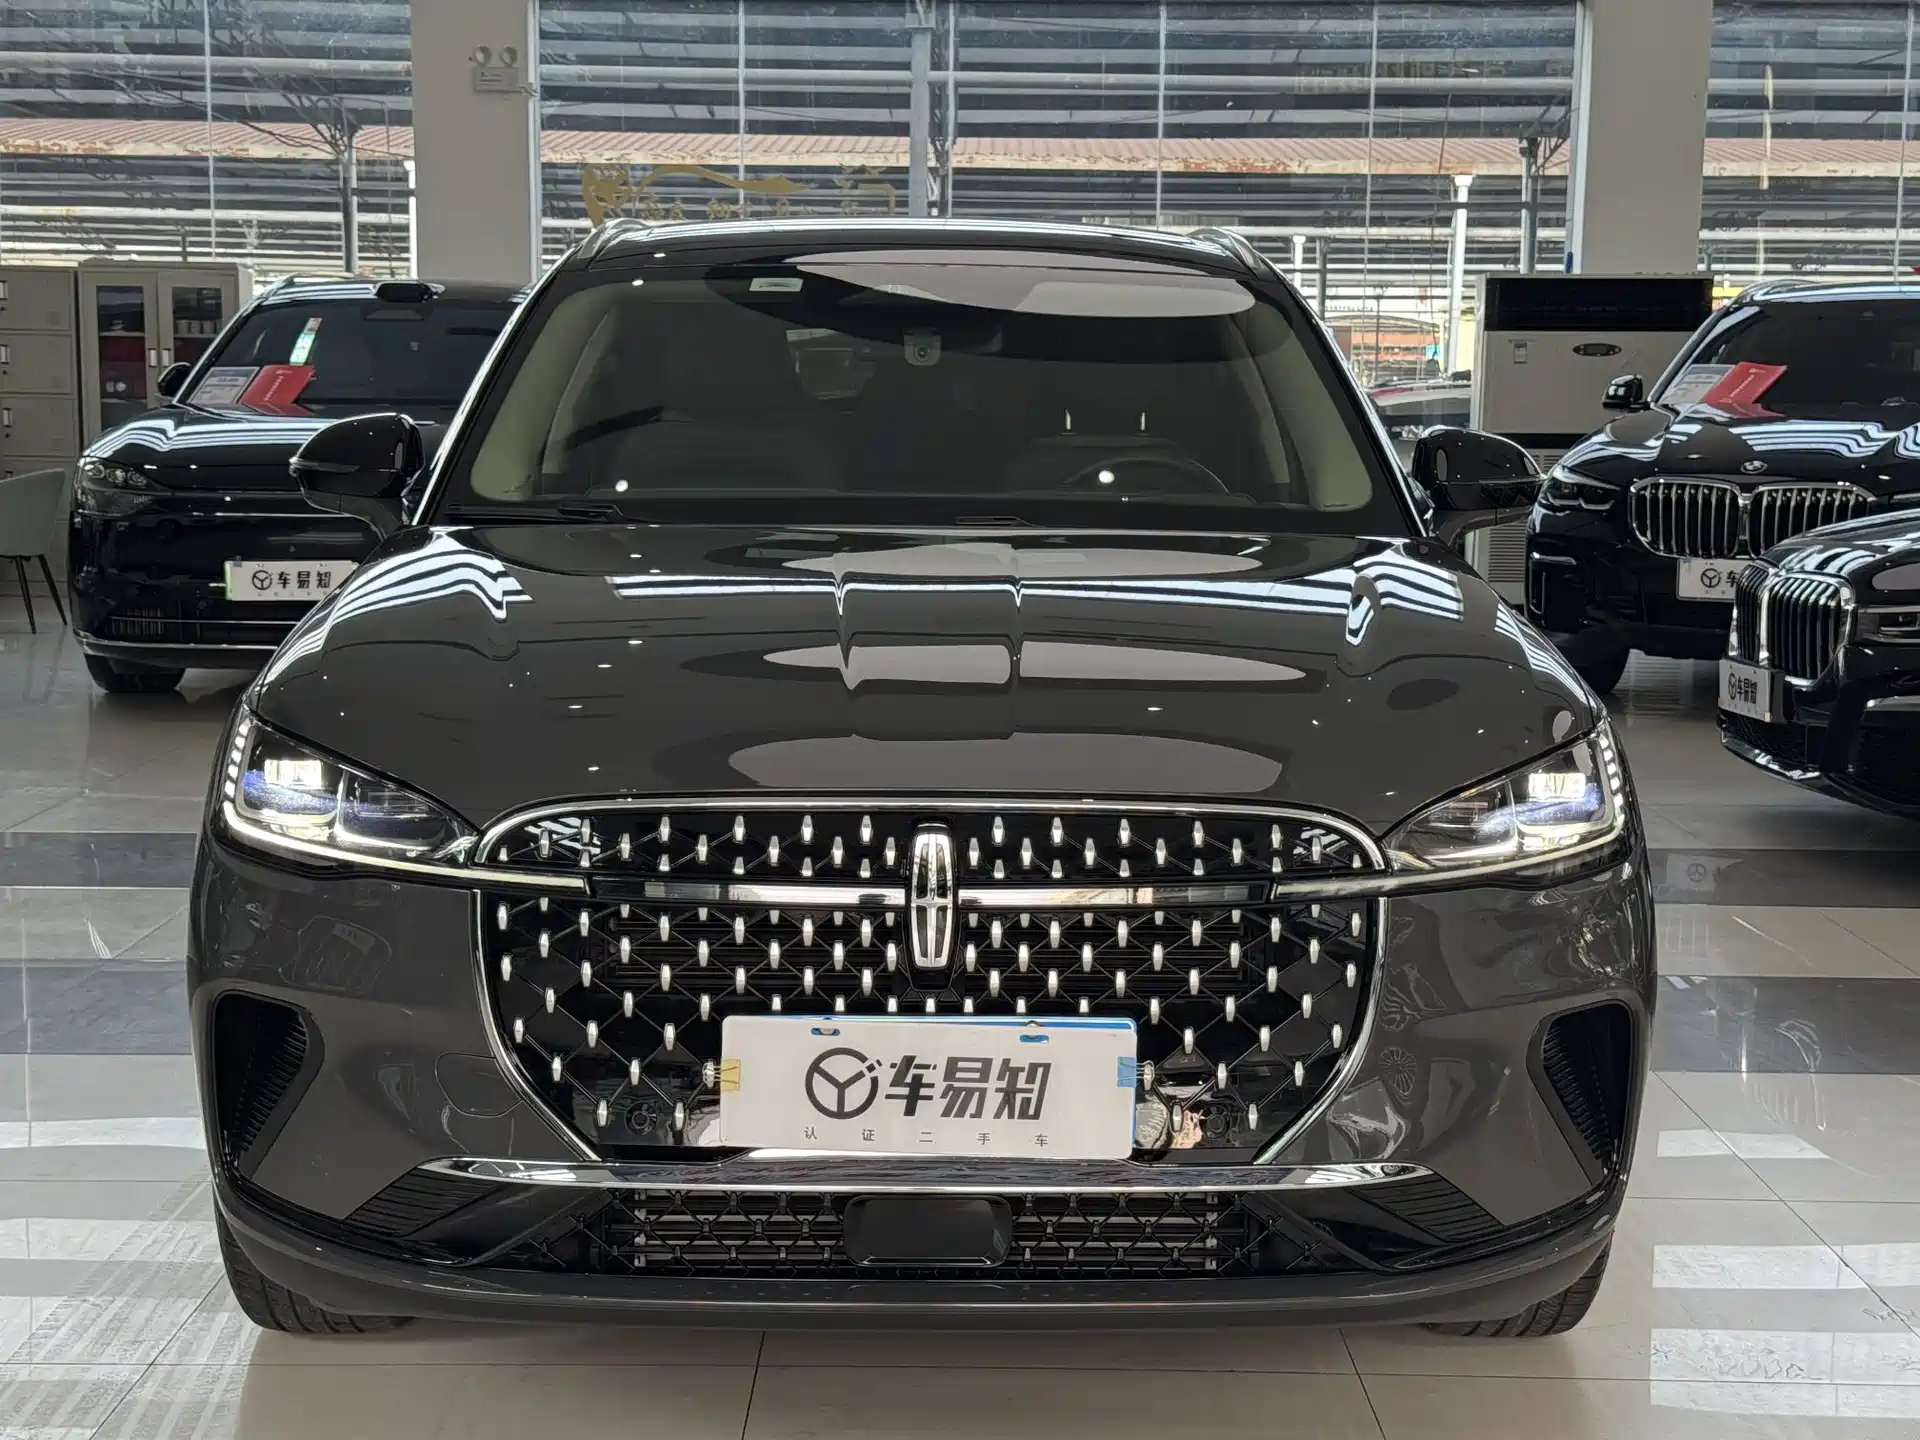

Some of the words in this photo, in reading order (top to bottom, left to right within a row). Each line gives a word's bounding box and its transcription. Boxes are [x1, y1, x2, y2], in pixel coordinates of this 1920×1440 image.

[277, 571, 332, 589] 车易知
[885, 1055, 1052, 1121] 车易知
[804, 1126, 1049, 1148] 认证二手车
